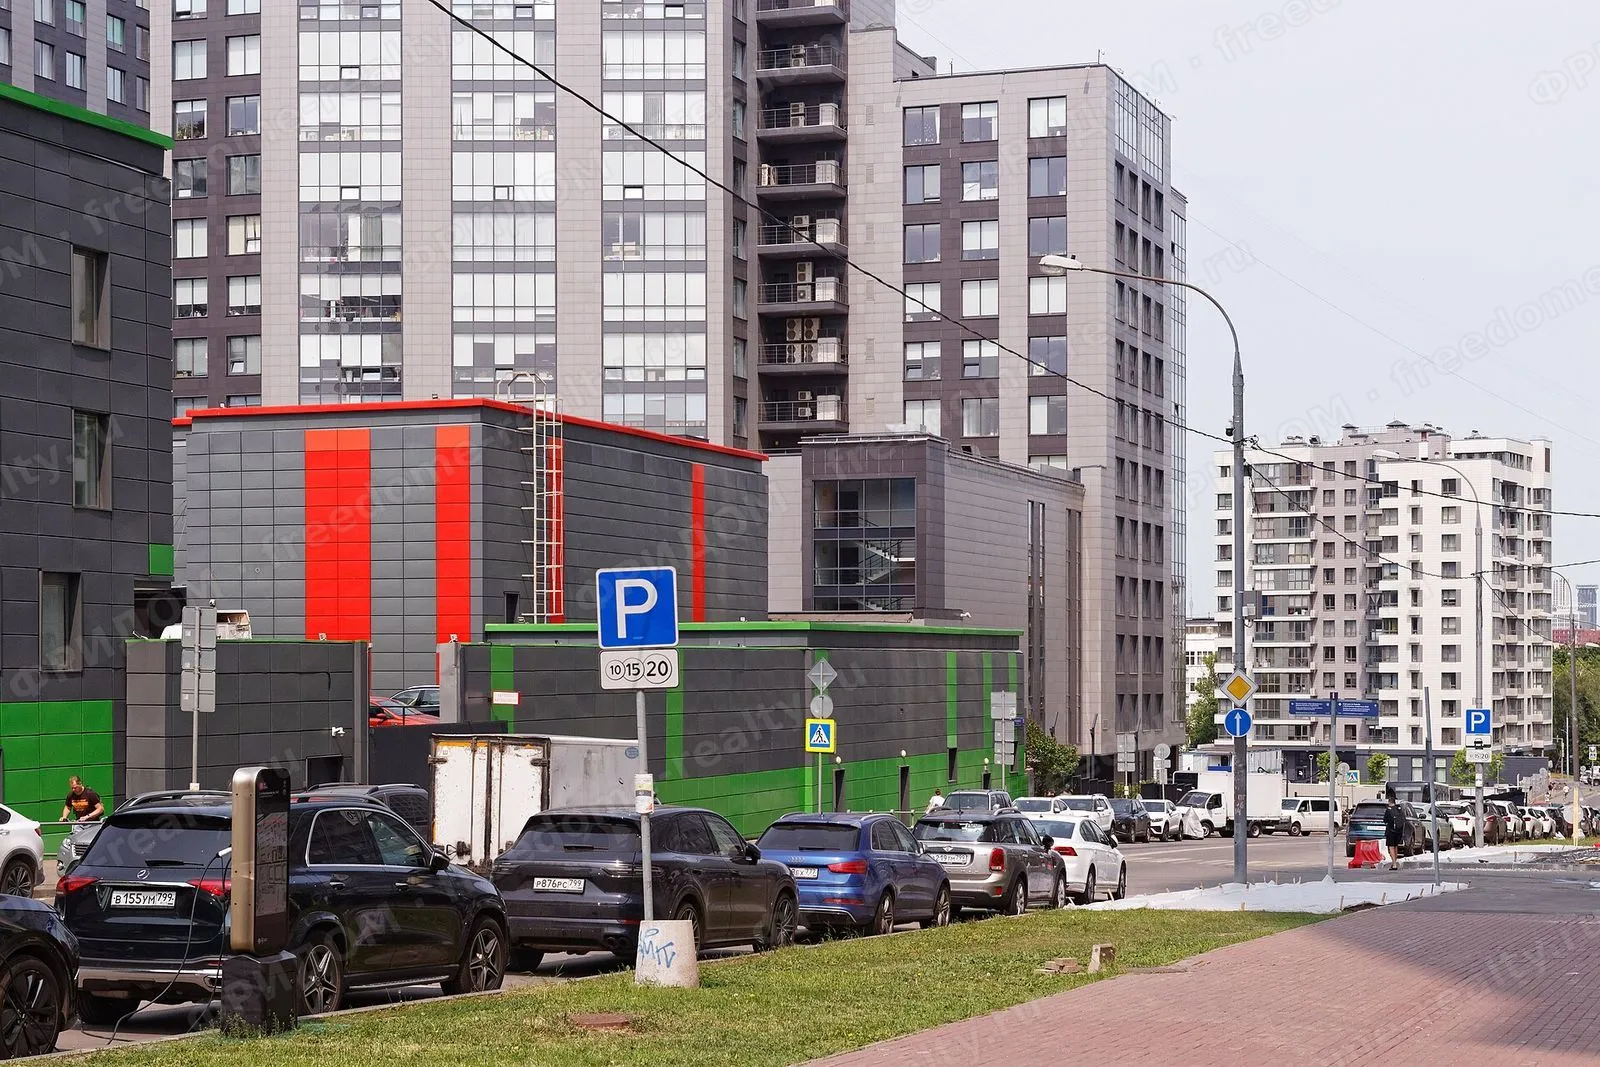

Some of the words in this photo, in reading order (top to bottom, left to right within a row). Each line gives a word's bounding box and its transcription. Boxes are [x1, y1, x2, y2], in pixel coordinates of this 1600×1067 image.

[615, 578, 658, 639] P
[610, 665, 622, 675] 10
[626, 663, 640, 676] 15
[647, 661, 668, 676] 20
[1471, 711, 1486, 732] P
